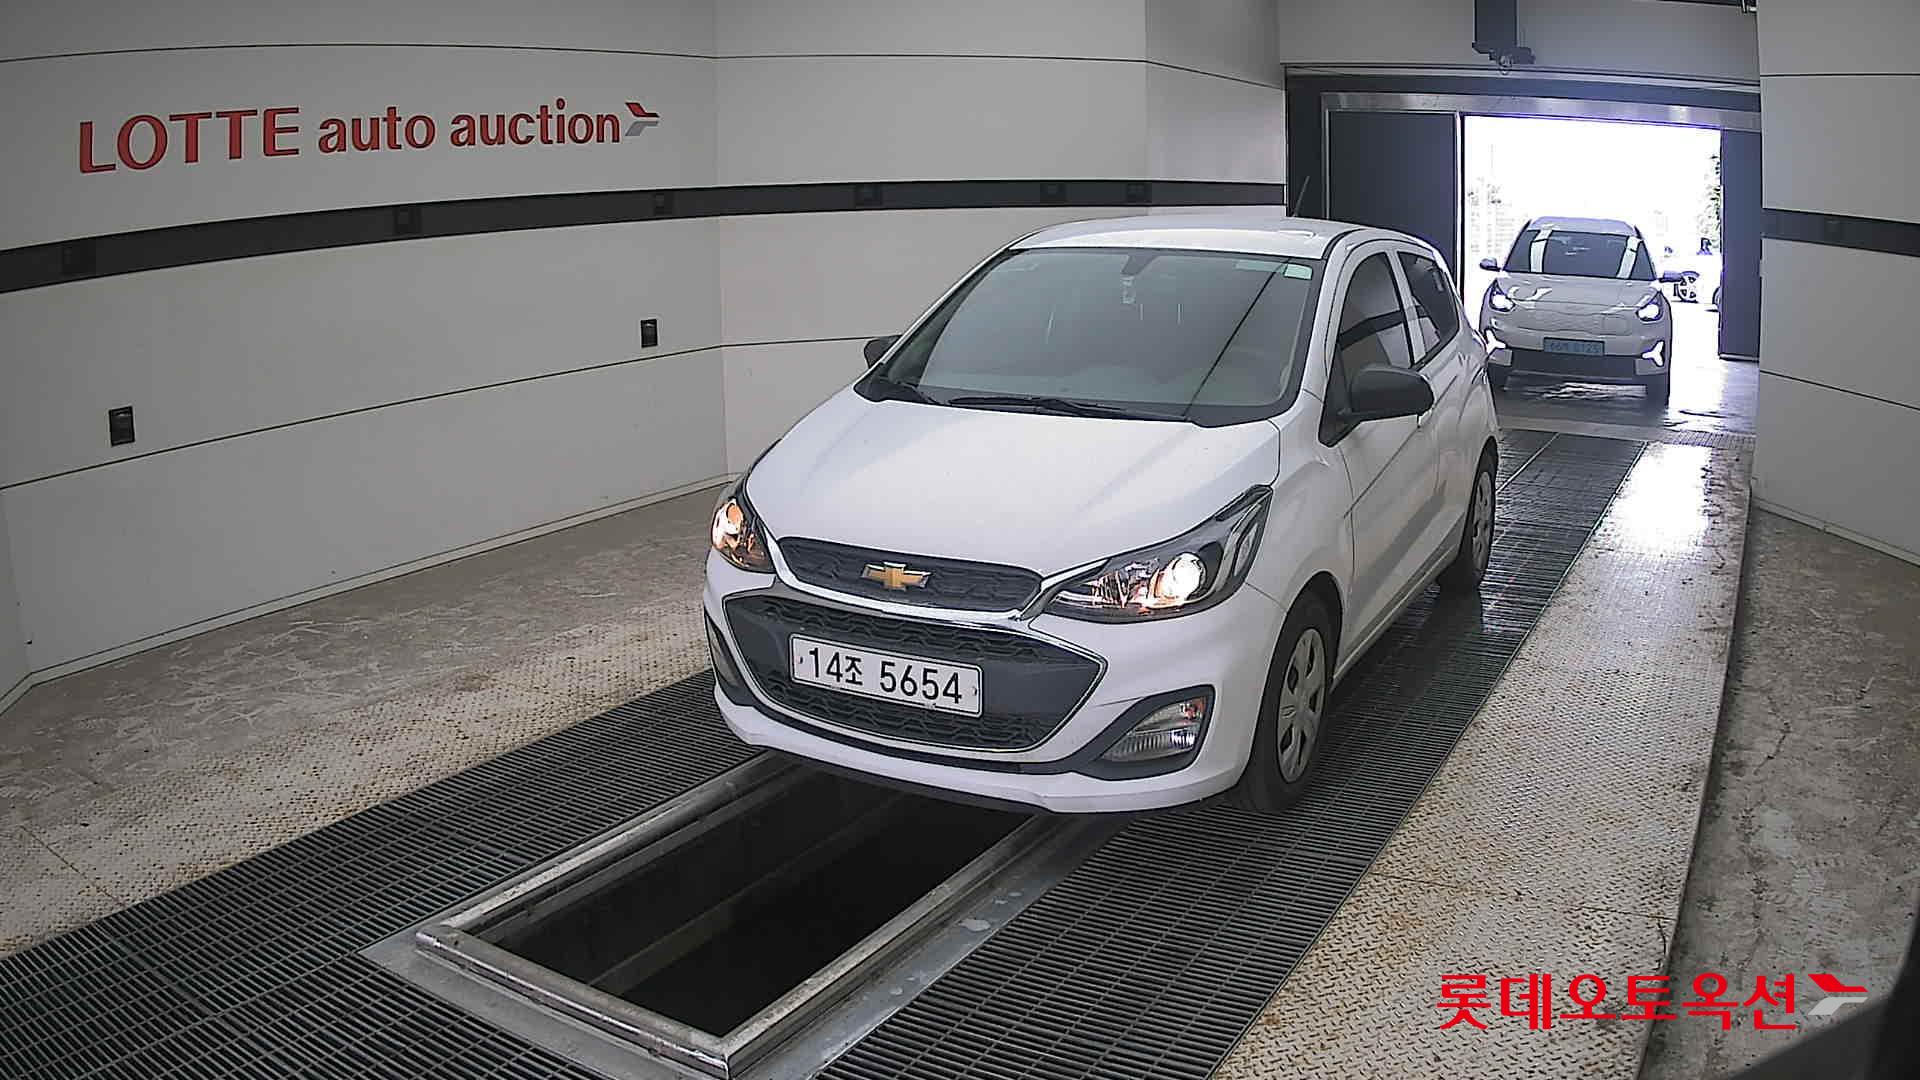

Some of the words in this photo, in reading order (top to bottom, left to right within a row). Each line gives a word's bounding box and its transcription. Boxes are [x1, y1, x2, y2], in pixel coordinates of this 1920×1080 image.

[79, 107, 300, 174] LOTTE
[318, 106, 437, 154] auto
[449, 97, 621, 147] auction
[808, 647, 863, 686] 14조
[879, 660, 963, 704] 5654
